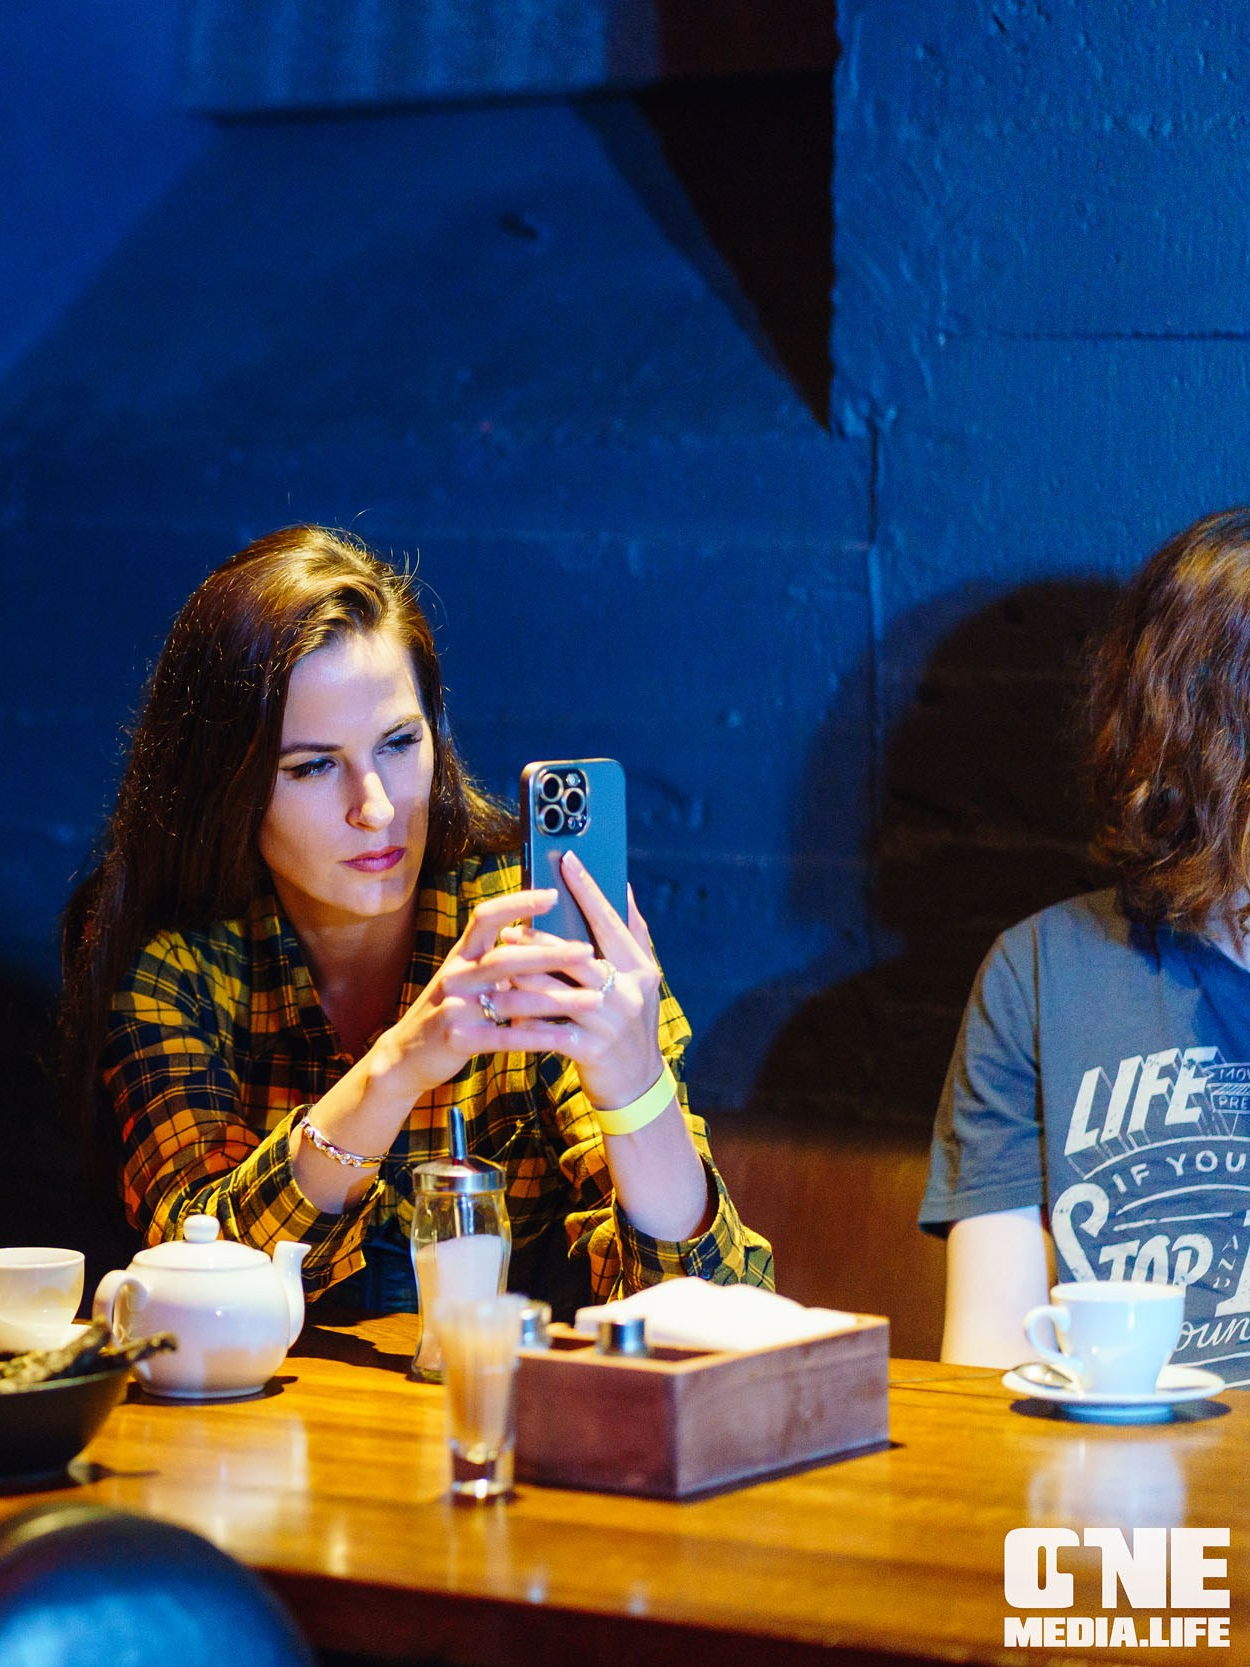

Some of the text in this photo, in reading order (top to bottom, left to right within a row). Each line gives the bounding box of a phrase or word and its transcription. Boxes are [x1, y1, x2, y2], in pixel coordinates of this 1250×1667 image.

[1064, 1046, 1220, 1157] LIFE
[1112, 1150, 1247, 1193] IF YOU
